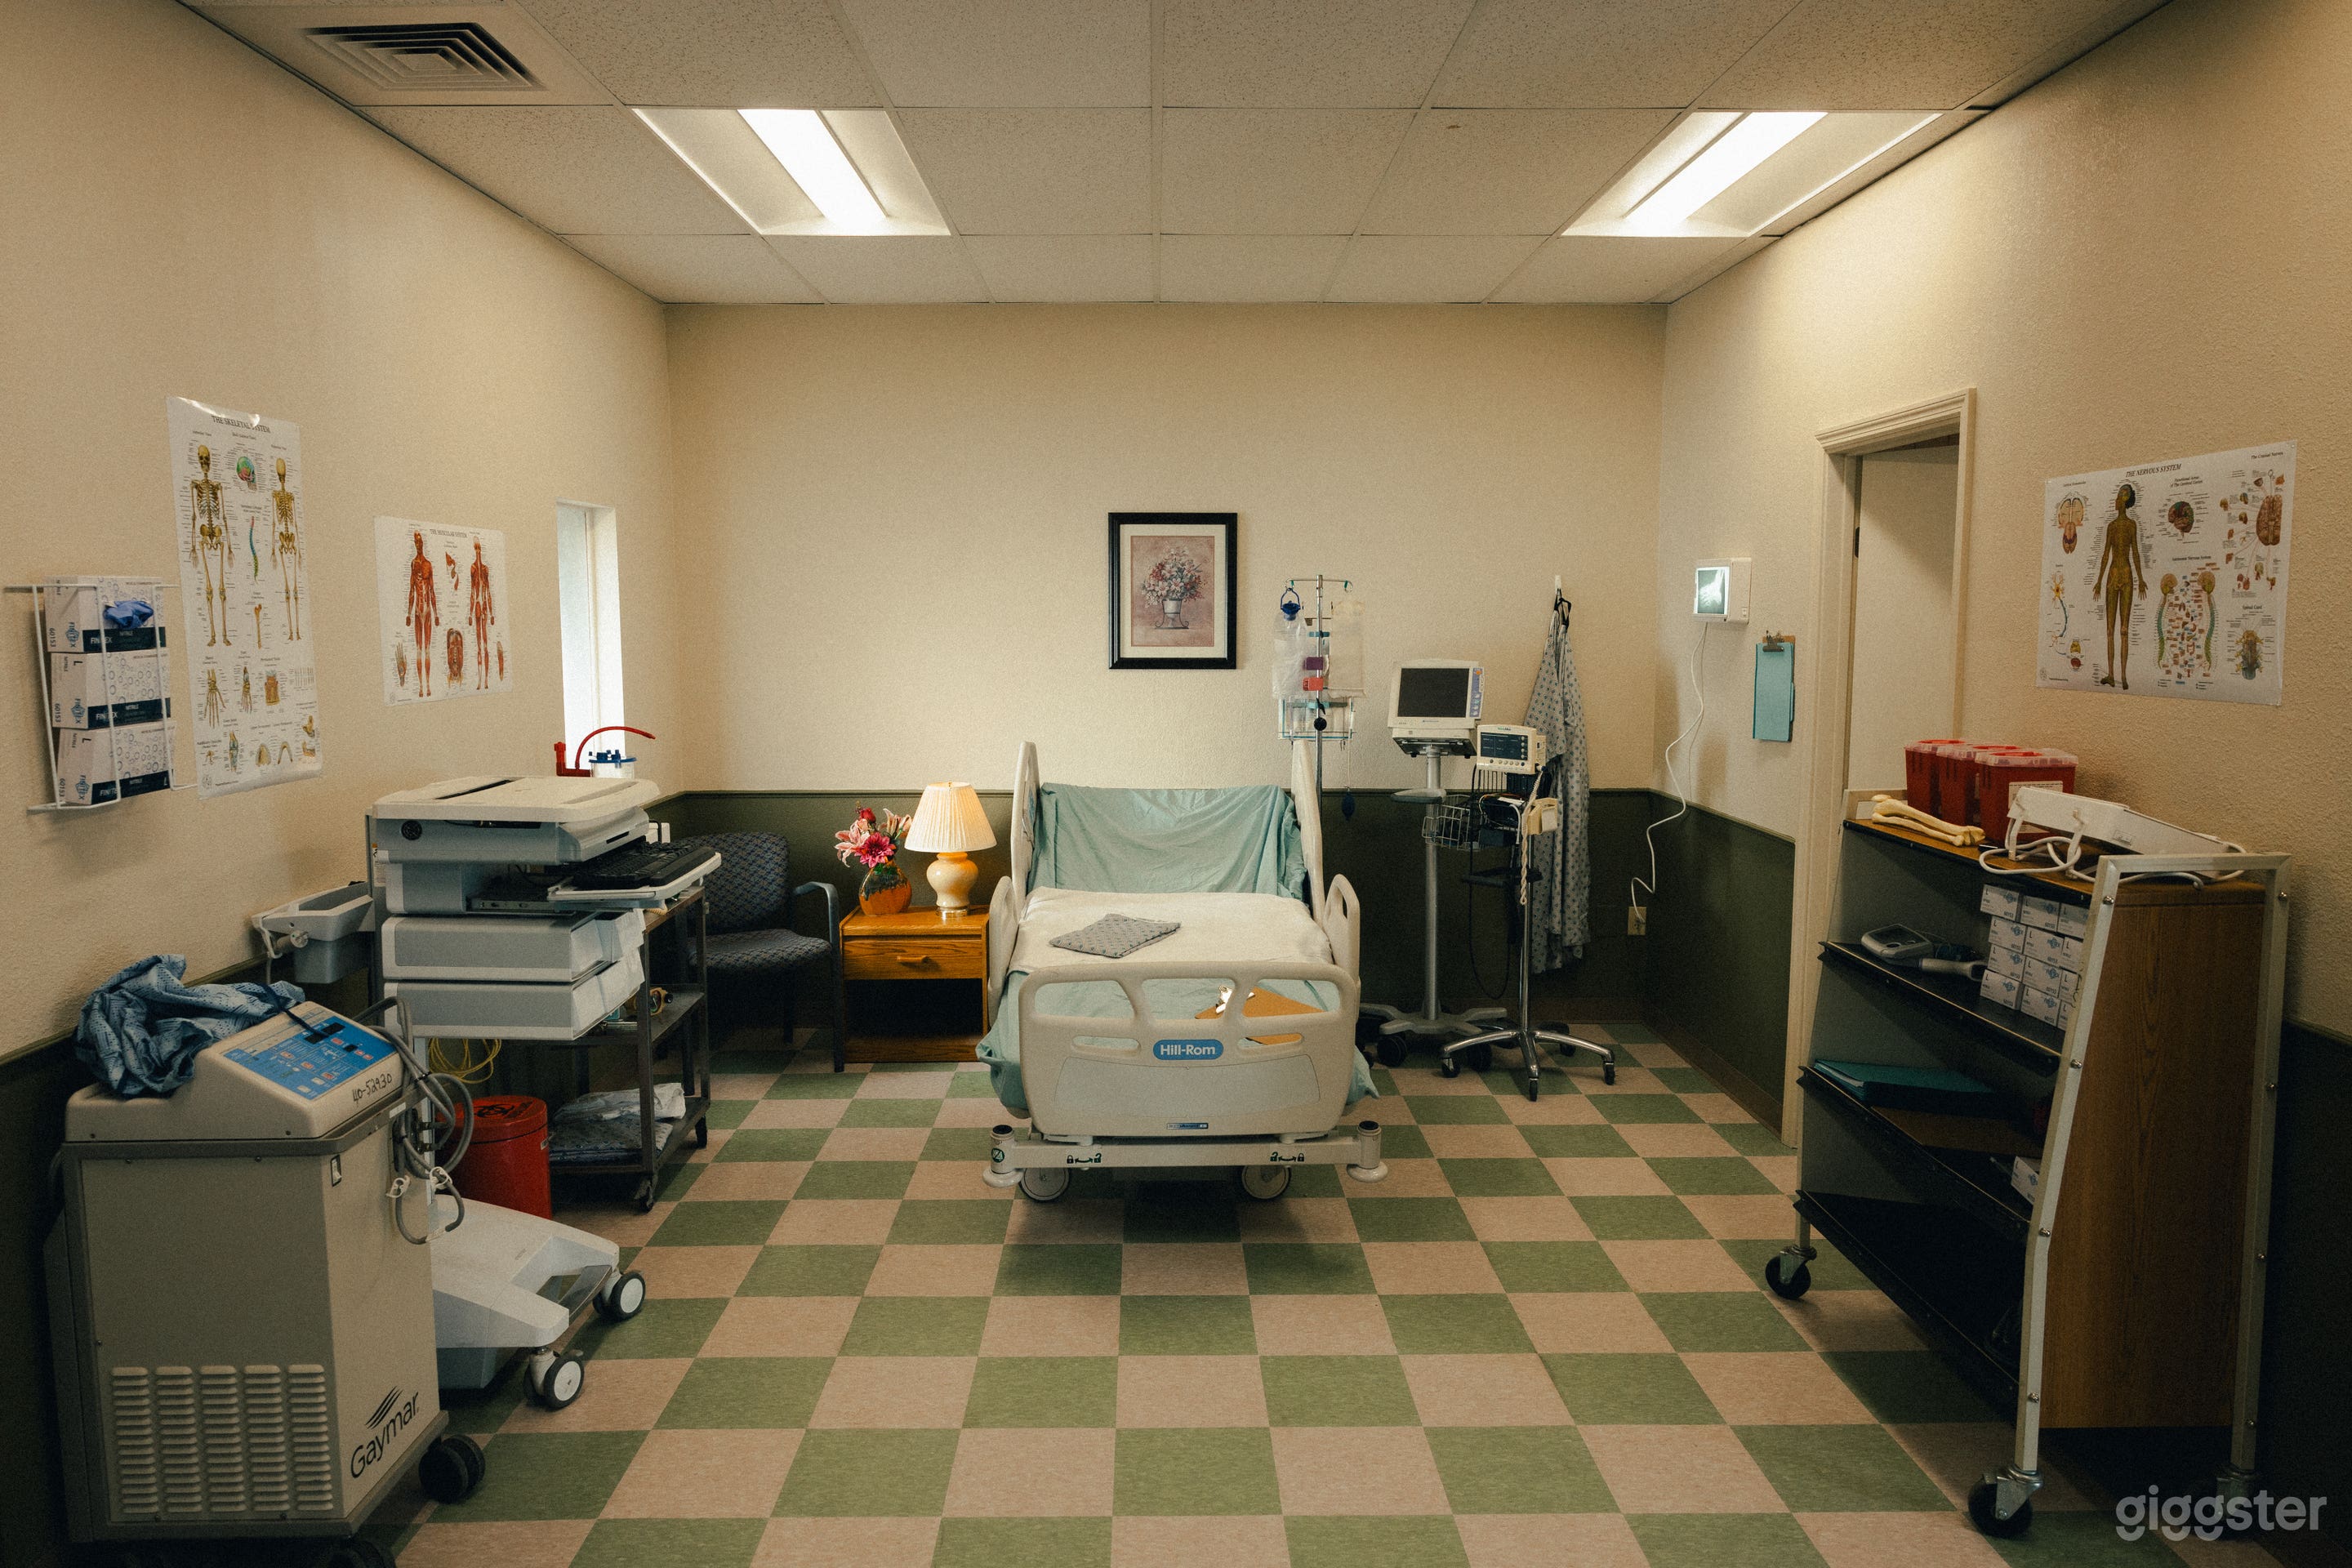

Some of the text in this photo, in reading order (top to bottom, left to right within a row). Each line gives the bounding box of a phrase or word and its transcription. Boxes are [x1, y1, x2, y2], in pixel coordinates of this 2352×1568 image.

[2136, 466, 2160, 476] NERVOUS
[2159, 463, 2182, 473] SYSTEM
[1160, 1045, 1216, 1056] Hill-Rom
[350, 1392, 419, 1479] Gaymar
